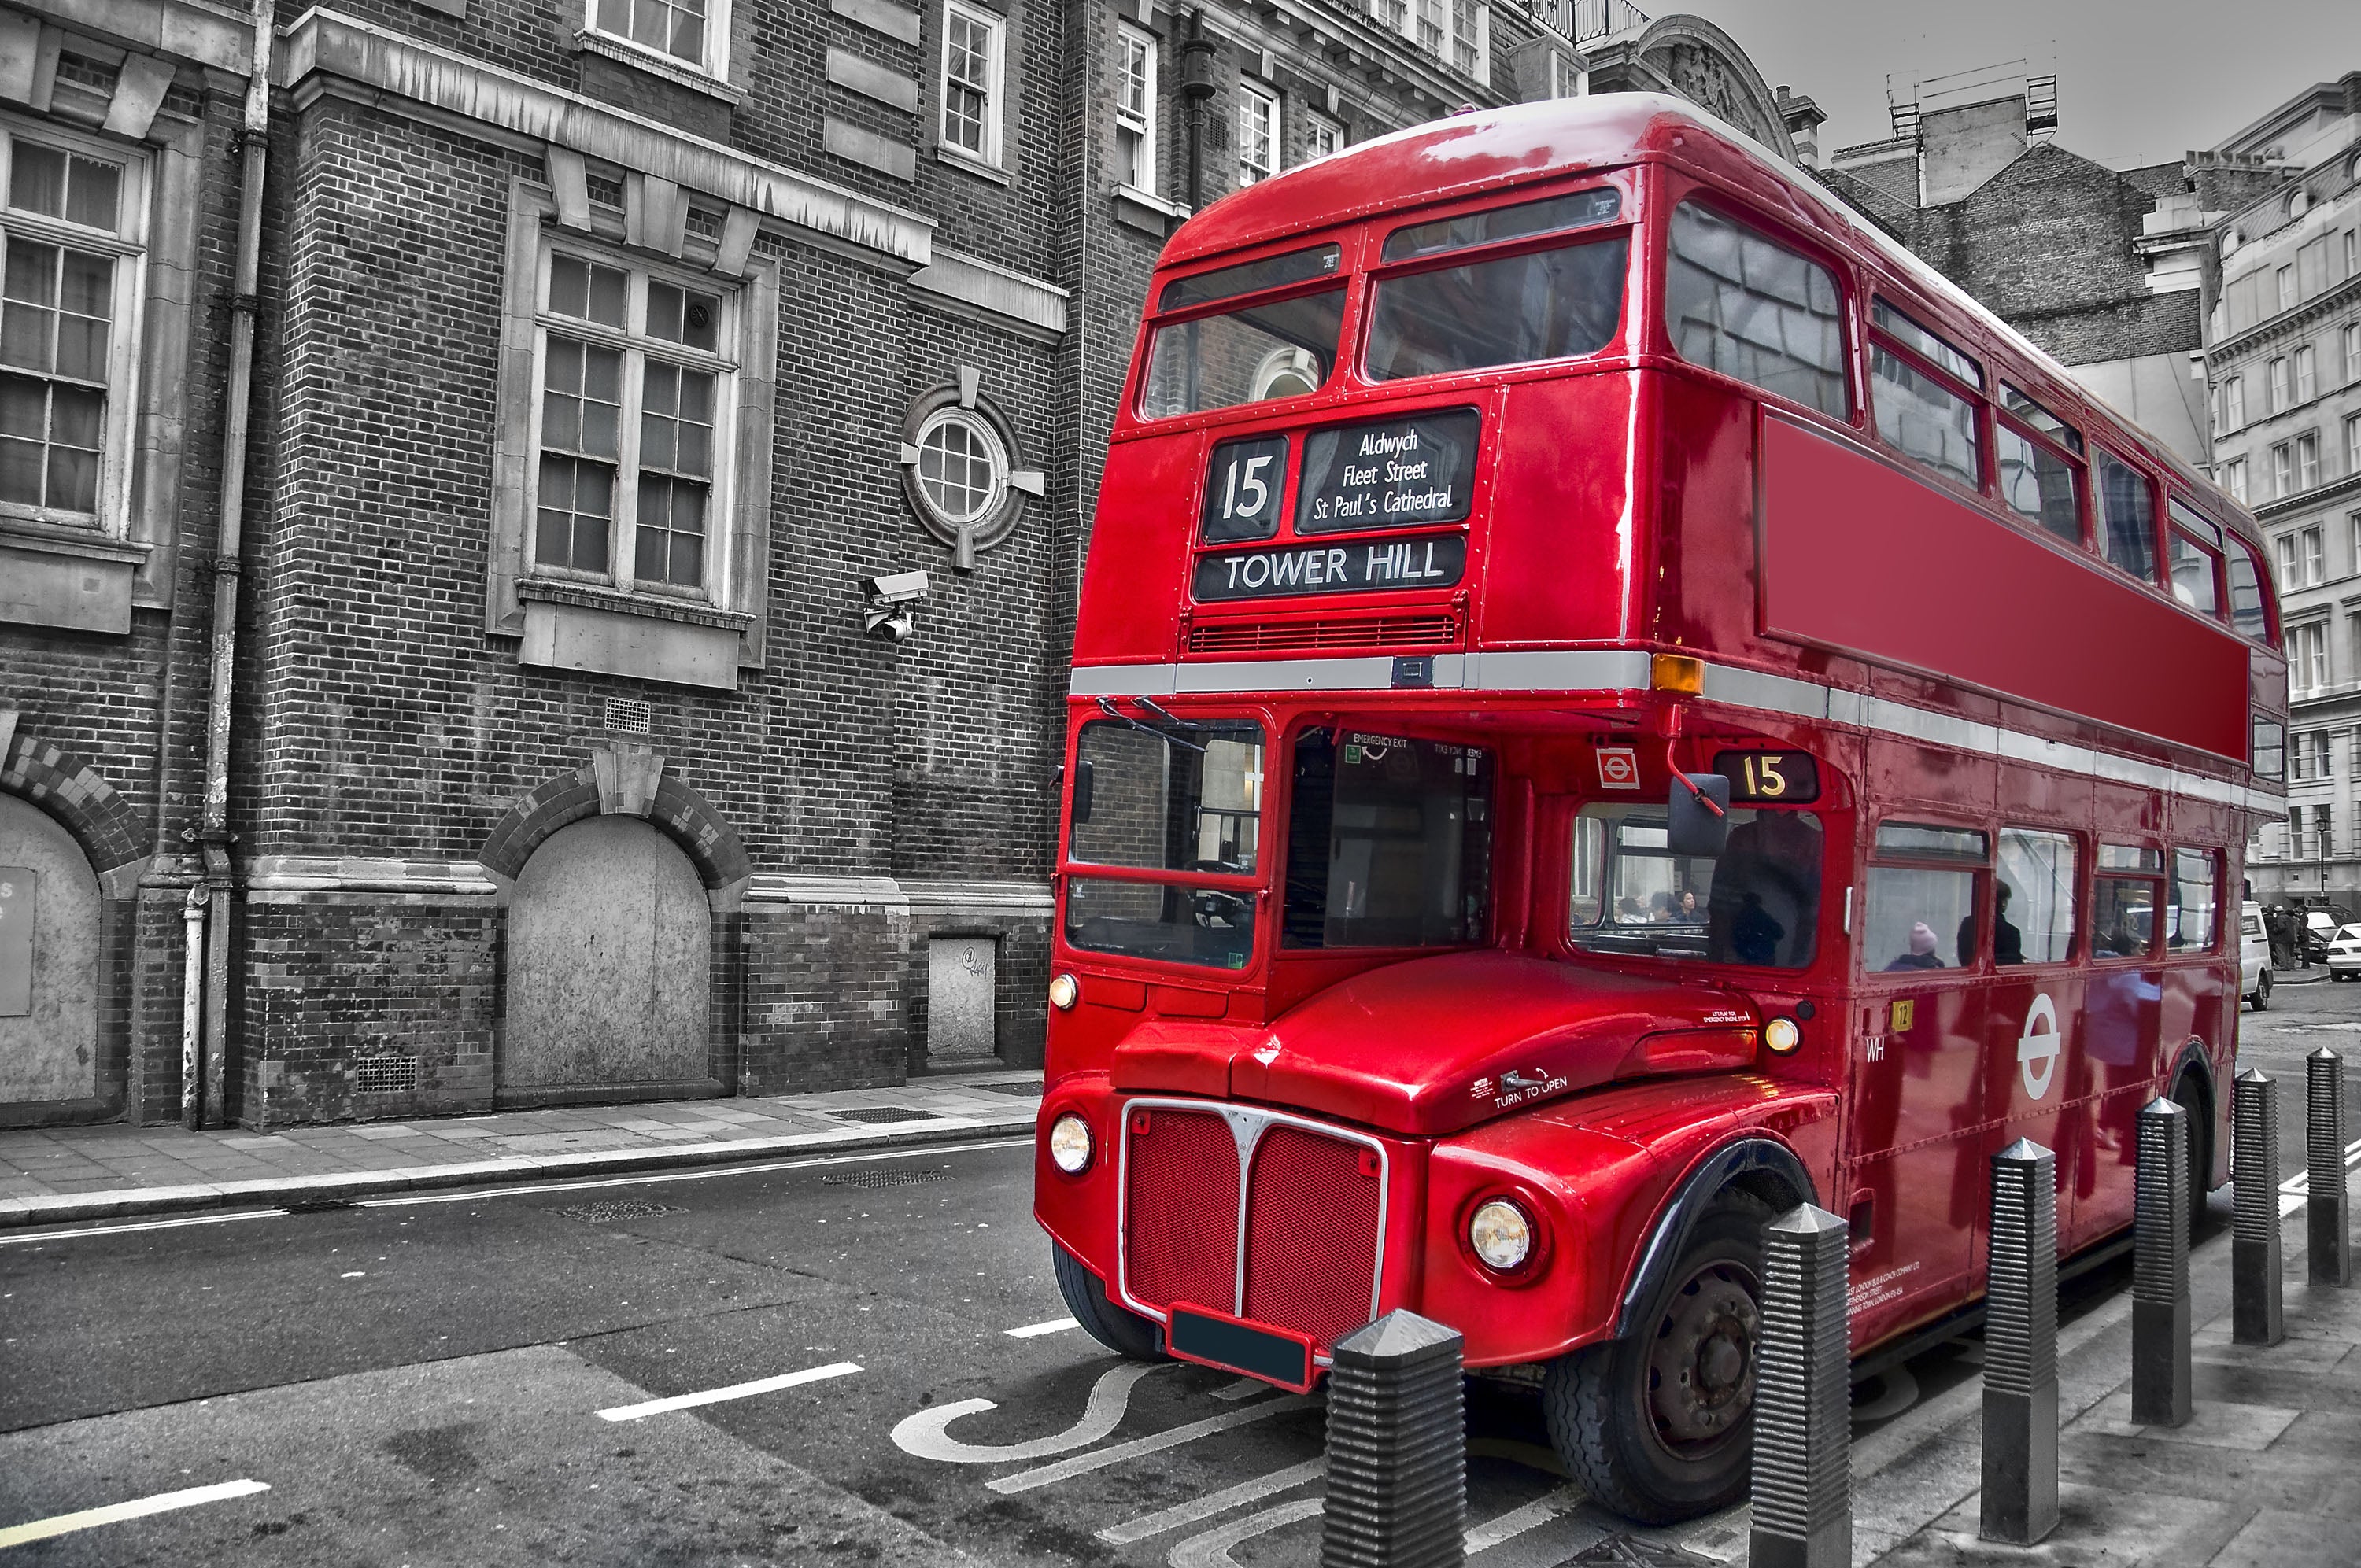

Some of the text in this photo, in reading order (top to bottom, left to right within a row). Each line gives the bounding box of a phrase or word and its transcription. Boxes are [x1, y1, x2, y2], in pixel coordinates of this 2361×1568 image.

[1359, 428, 1418, 459] Aldwych
[1223, 455, 1273, 519] 15
[1343, 460, 1428, 488] Fleet Street
[1314, 485, 1453, 520] St Paul's Cathedral
[1224, 542, 1444, 589] TOWER HILL
[1354, 733, 1407, 748] EMERGENCY EXIT
[1744, 755, 1786, 796] 15
[1899, 1004, 1908, 1025] 12
[1866, 1037, 1884, 1062] WH
[1495, 1075, 1568, 1109] TURN TO OPEN
